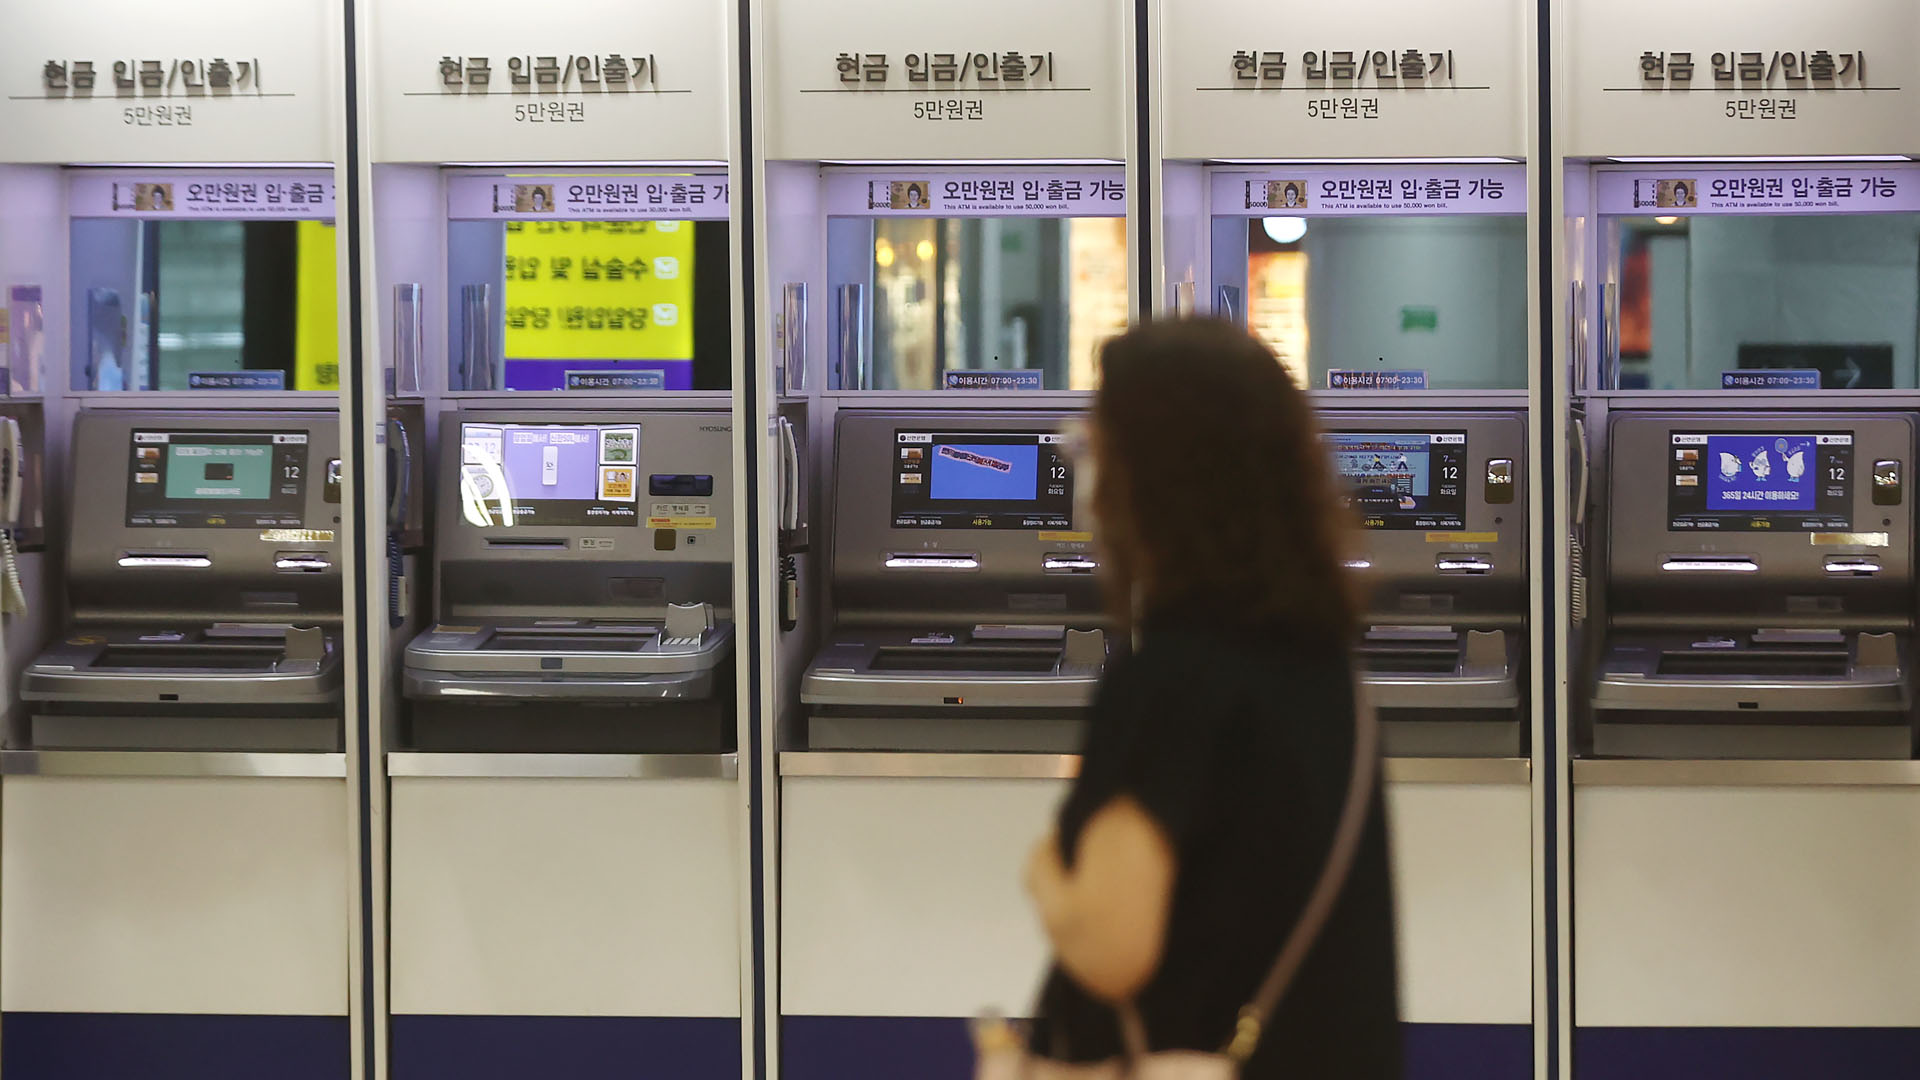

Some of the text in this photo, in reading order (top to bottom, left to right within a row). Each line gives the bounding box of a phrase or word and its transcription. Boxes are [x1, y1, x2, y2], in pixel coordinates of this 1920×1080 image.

[44, 58, 261, 90] 현금 입금/인출기
[439, 54, 655, 85] 현금 입금/인출기
[836, 51, 1053, 82] 현금 입금/인출기
[1232, 49, 1453, 80] 현금 입금/인출기
[1640, 50, 1863, 81] 현금 입금/인출기
[123, 105, 193, 127] 5만원권
[514, 101, 585, 123] 5만원권
[913, 99, 984, 121] 5만원권
[1307, 97, 1380, 119] 5만원권
[1725, 98, 1797, 120] 5만원권
[186, 183, 258, 203] 오만원권
[567, 183, 729, 204] 오만원권 입·출금 가
[943, 180, 1126, 201] 오만원권 입·출금 가능
[1320, 179, 1504, 200] 오만원권 입·출금 가능
[1710, 177, 1897, 198] 오만원권 입·출금 가능
[580, 377, 610, 387] 이용시간
[958, 376, 988, 386] 이용시간
[1343, 376, 1373, 386] 이용시간
[1734, 375, 1764, 386] 이용시간
[284, 466, 299, 478] 12
[1050, 466, 1066, 479] 12
[1442, 466, 1458, 479] 12
[1828, 468, 1845, 480] 12
[1742, 490, 1764, 500] 24시간
